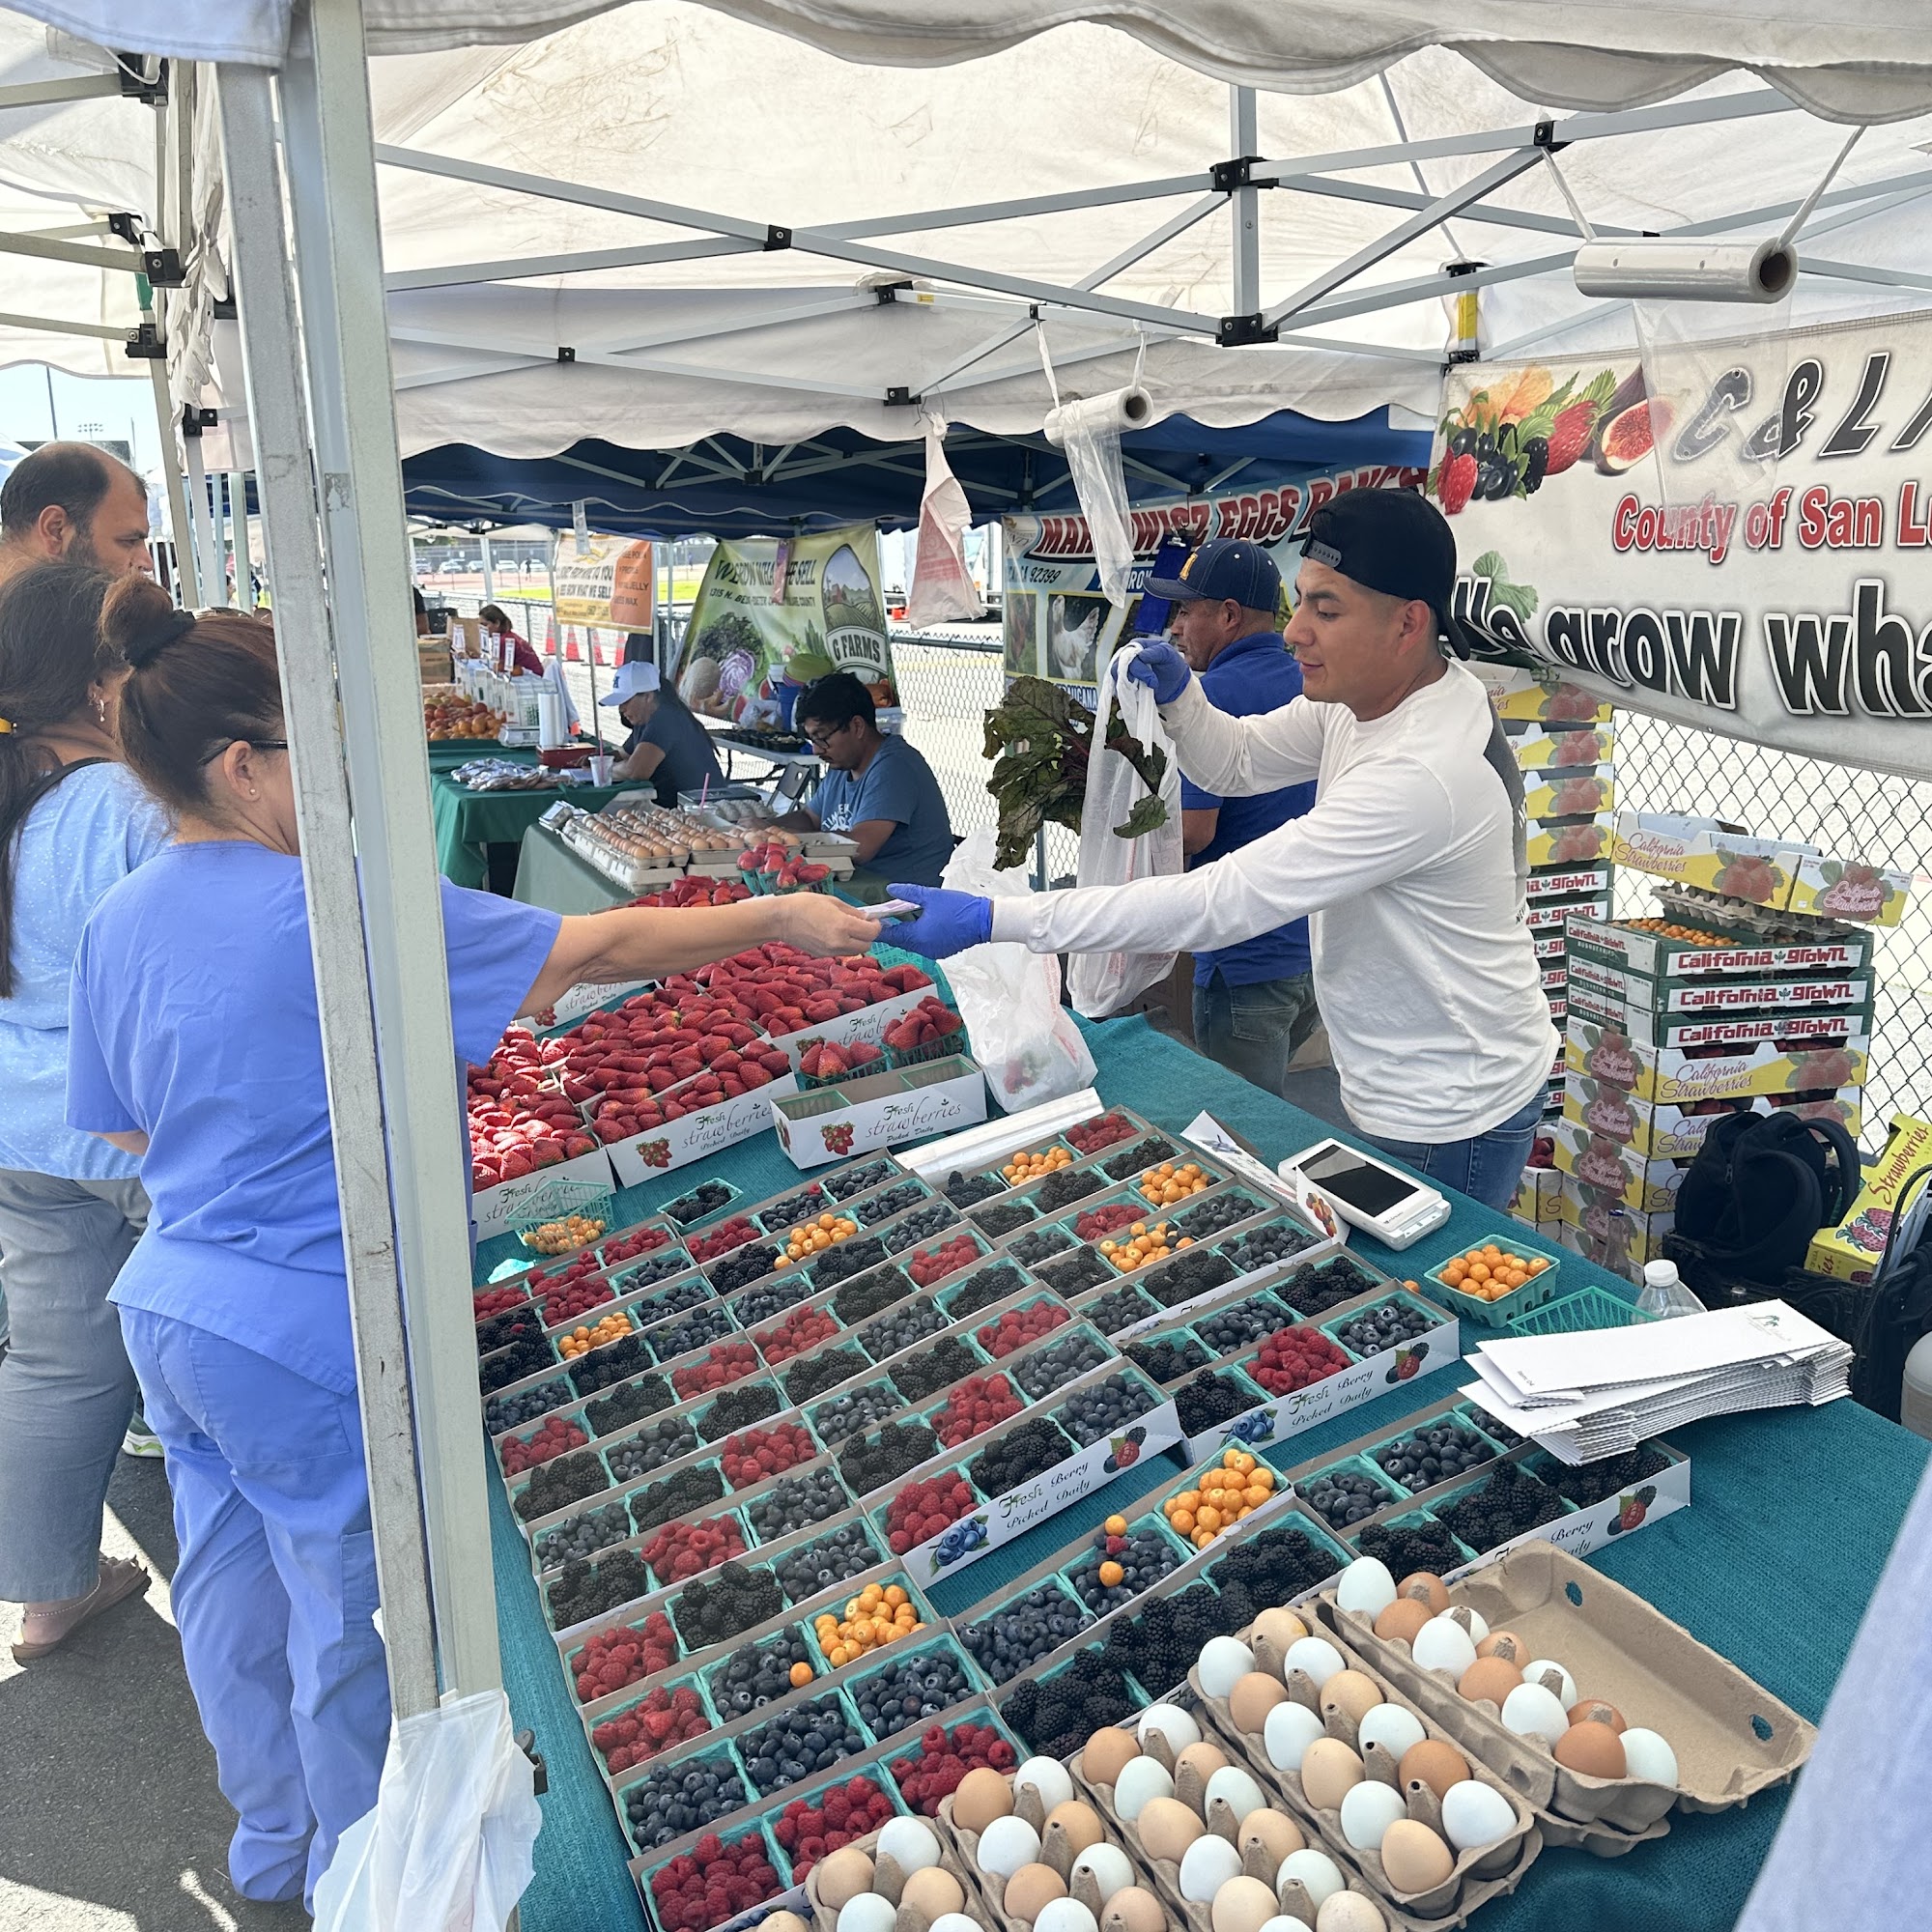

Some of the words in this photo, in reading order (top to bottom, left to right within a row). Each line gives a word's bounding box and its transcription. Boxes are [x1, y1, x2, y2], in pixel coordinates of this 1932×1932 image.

[1215, 487, 1300, 540] EGGS
[1613, 494, 1737, 564] County
[1745, 487, 1794, 550] of
[1798, 485, 1884, 551] San
[755, 561, 775, 586] WHA
[1030, 566, 1062, 584] 92399
[833, 639, 841, 662] G
[840, 634, 881, 664] FARMS
[1615, 842, 1687, 872] Strawberries
[1629, 832, 1685, 859] California
[1678, 951, 1775, 969] California
[1783, 947, 1849, 964] grown
[1680, 987, 1779, 1006] California
[1789, 983, 1855, 1001] grown
[849, 1013, 877, 1032] Fresh
[1678, 1022, 1775, 1042] California
[1783, 1017, 1850, 1035] grown
[1675, 1060, 1748, 1086] California
[1660, 1074, 1753, 1099] Strawberries
[695, 1112, 726, 1131] Fresh
[865, 1095, 962, 1139] strawberries
[882, 1102, 915, 1122] Fresh
[681, 1103, 774, 1150] strawberries
[886, 1131, 910, 1143] Picked
[914, 1125, 935, 1136] Daily
[1867, 1125, 1930, 1207] Strawberries
[498, 1182, 532, 1204] Fresh
[1287, 1385, 1330, 1415] Fresh
[1337, 1370, 1374, 1391] Berry
[1291, 1402, 1333, 1429] Picked
[1339, 1386, 1373, 1407] Daily
[998, 1483, 1044, 1519] Fresh
[1050, 1462, 1089, 1488] Berry
[1007, 1499, 1049, 1532] Picked
[1056, 1479, 1091, 1504] Daily
[1549, 1520, 1595, 1545] Berry
